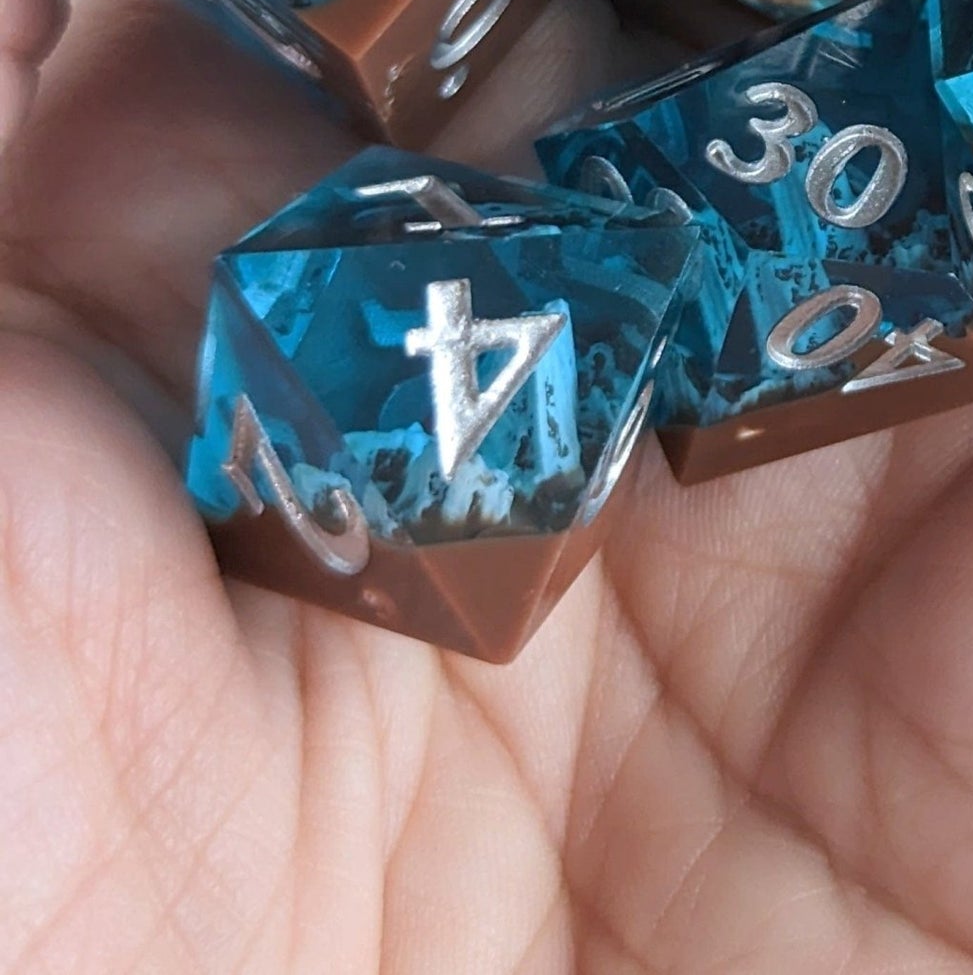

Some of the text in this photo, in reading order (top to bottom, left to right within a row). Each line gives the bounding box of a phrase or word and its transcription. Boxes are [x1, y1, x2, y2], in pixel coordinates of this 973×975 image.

[705, 81, 909, 228] 30
[404, 277, 569, 482] 4
[766, 284, 967, 395] 40
[221, 393, 371, 576] 2
